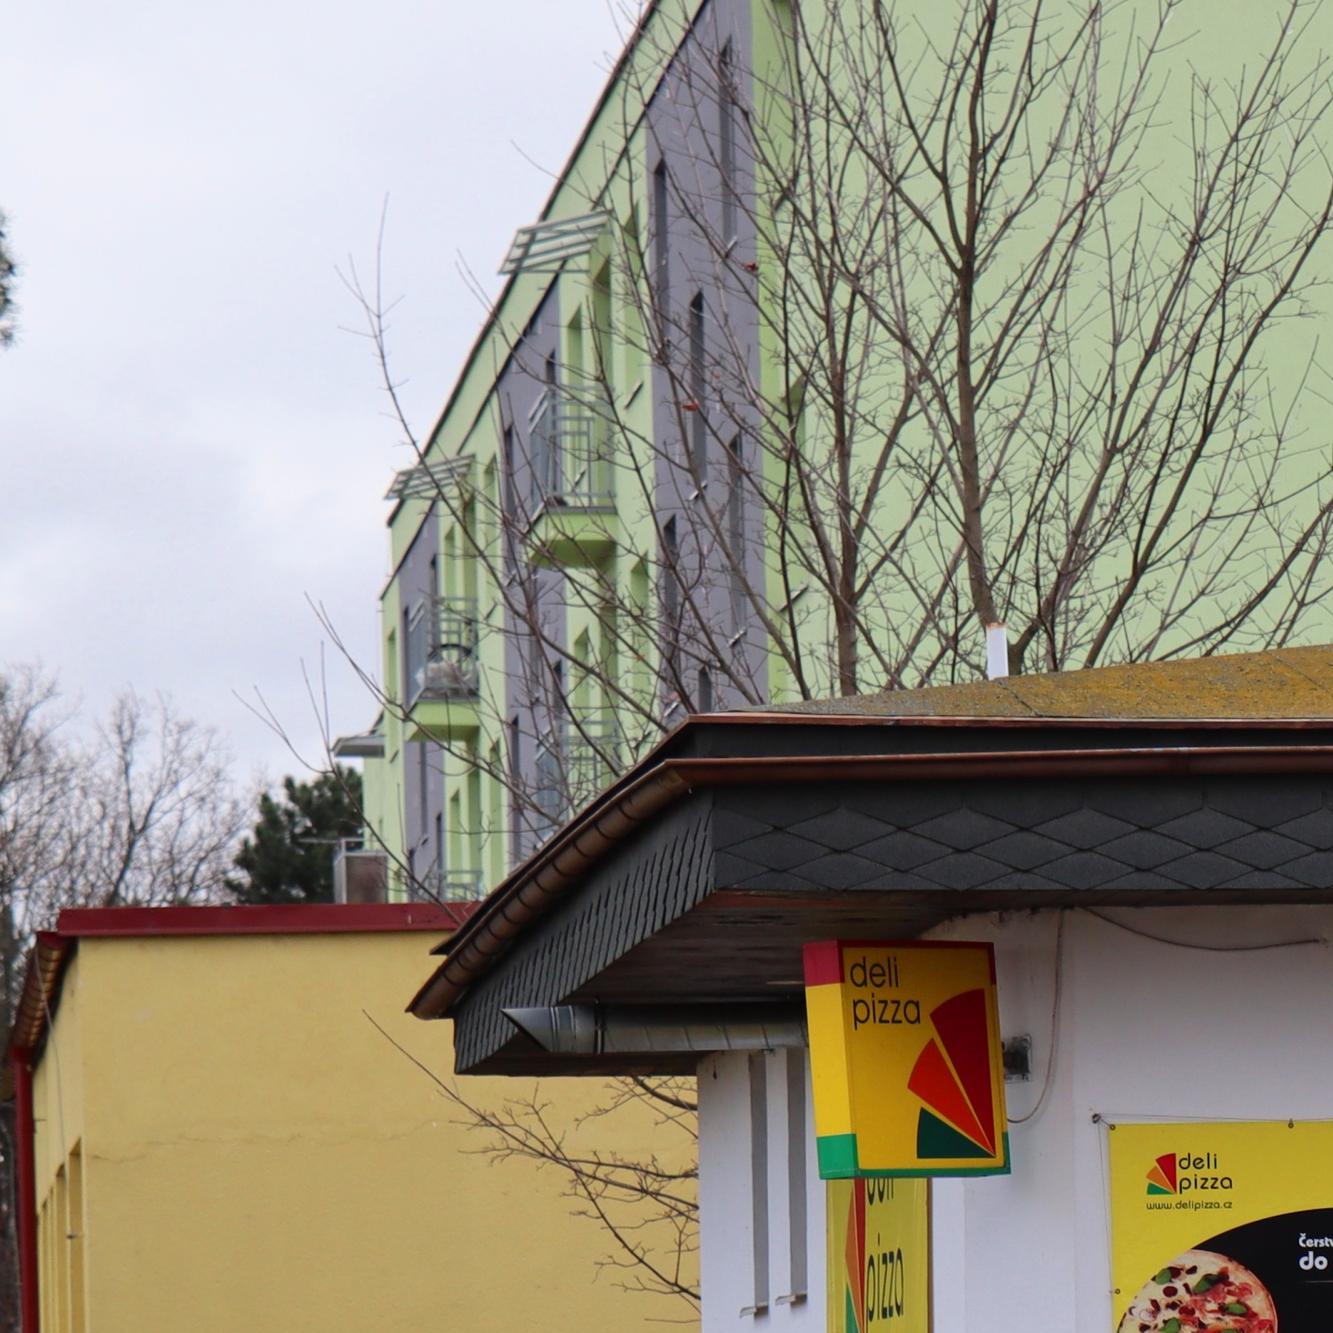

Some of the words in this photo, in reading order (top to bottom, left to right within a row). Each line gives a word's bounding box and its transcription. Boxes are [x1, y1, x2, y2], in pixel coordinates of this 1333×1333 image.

[851, 956, 899, 987] deli
[853, 993, 920, 1030] pizza
[1179, 1152, 1216, 1169] deli
[1179, 1174, 1232, 1194] pizza
[1146, 1200, 1232, 1211] www.delipizza.cz
[1299, 1251, 1328, 1270] do
